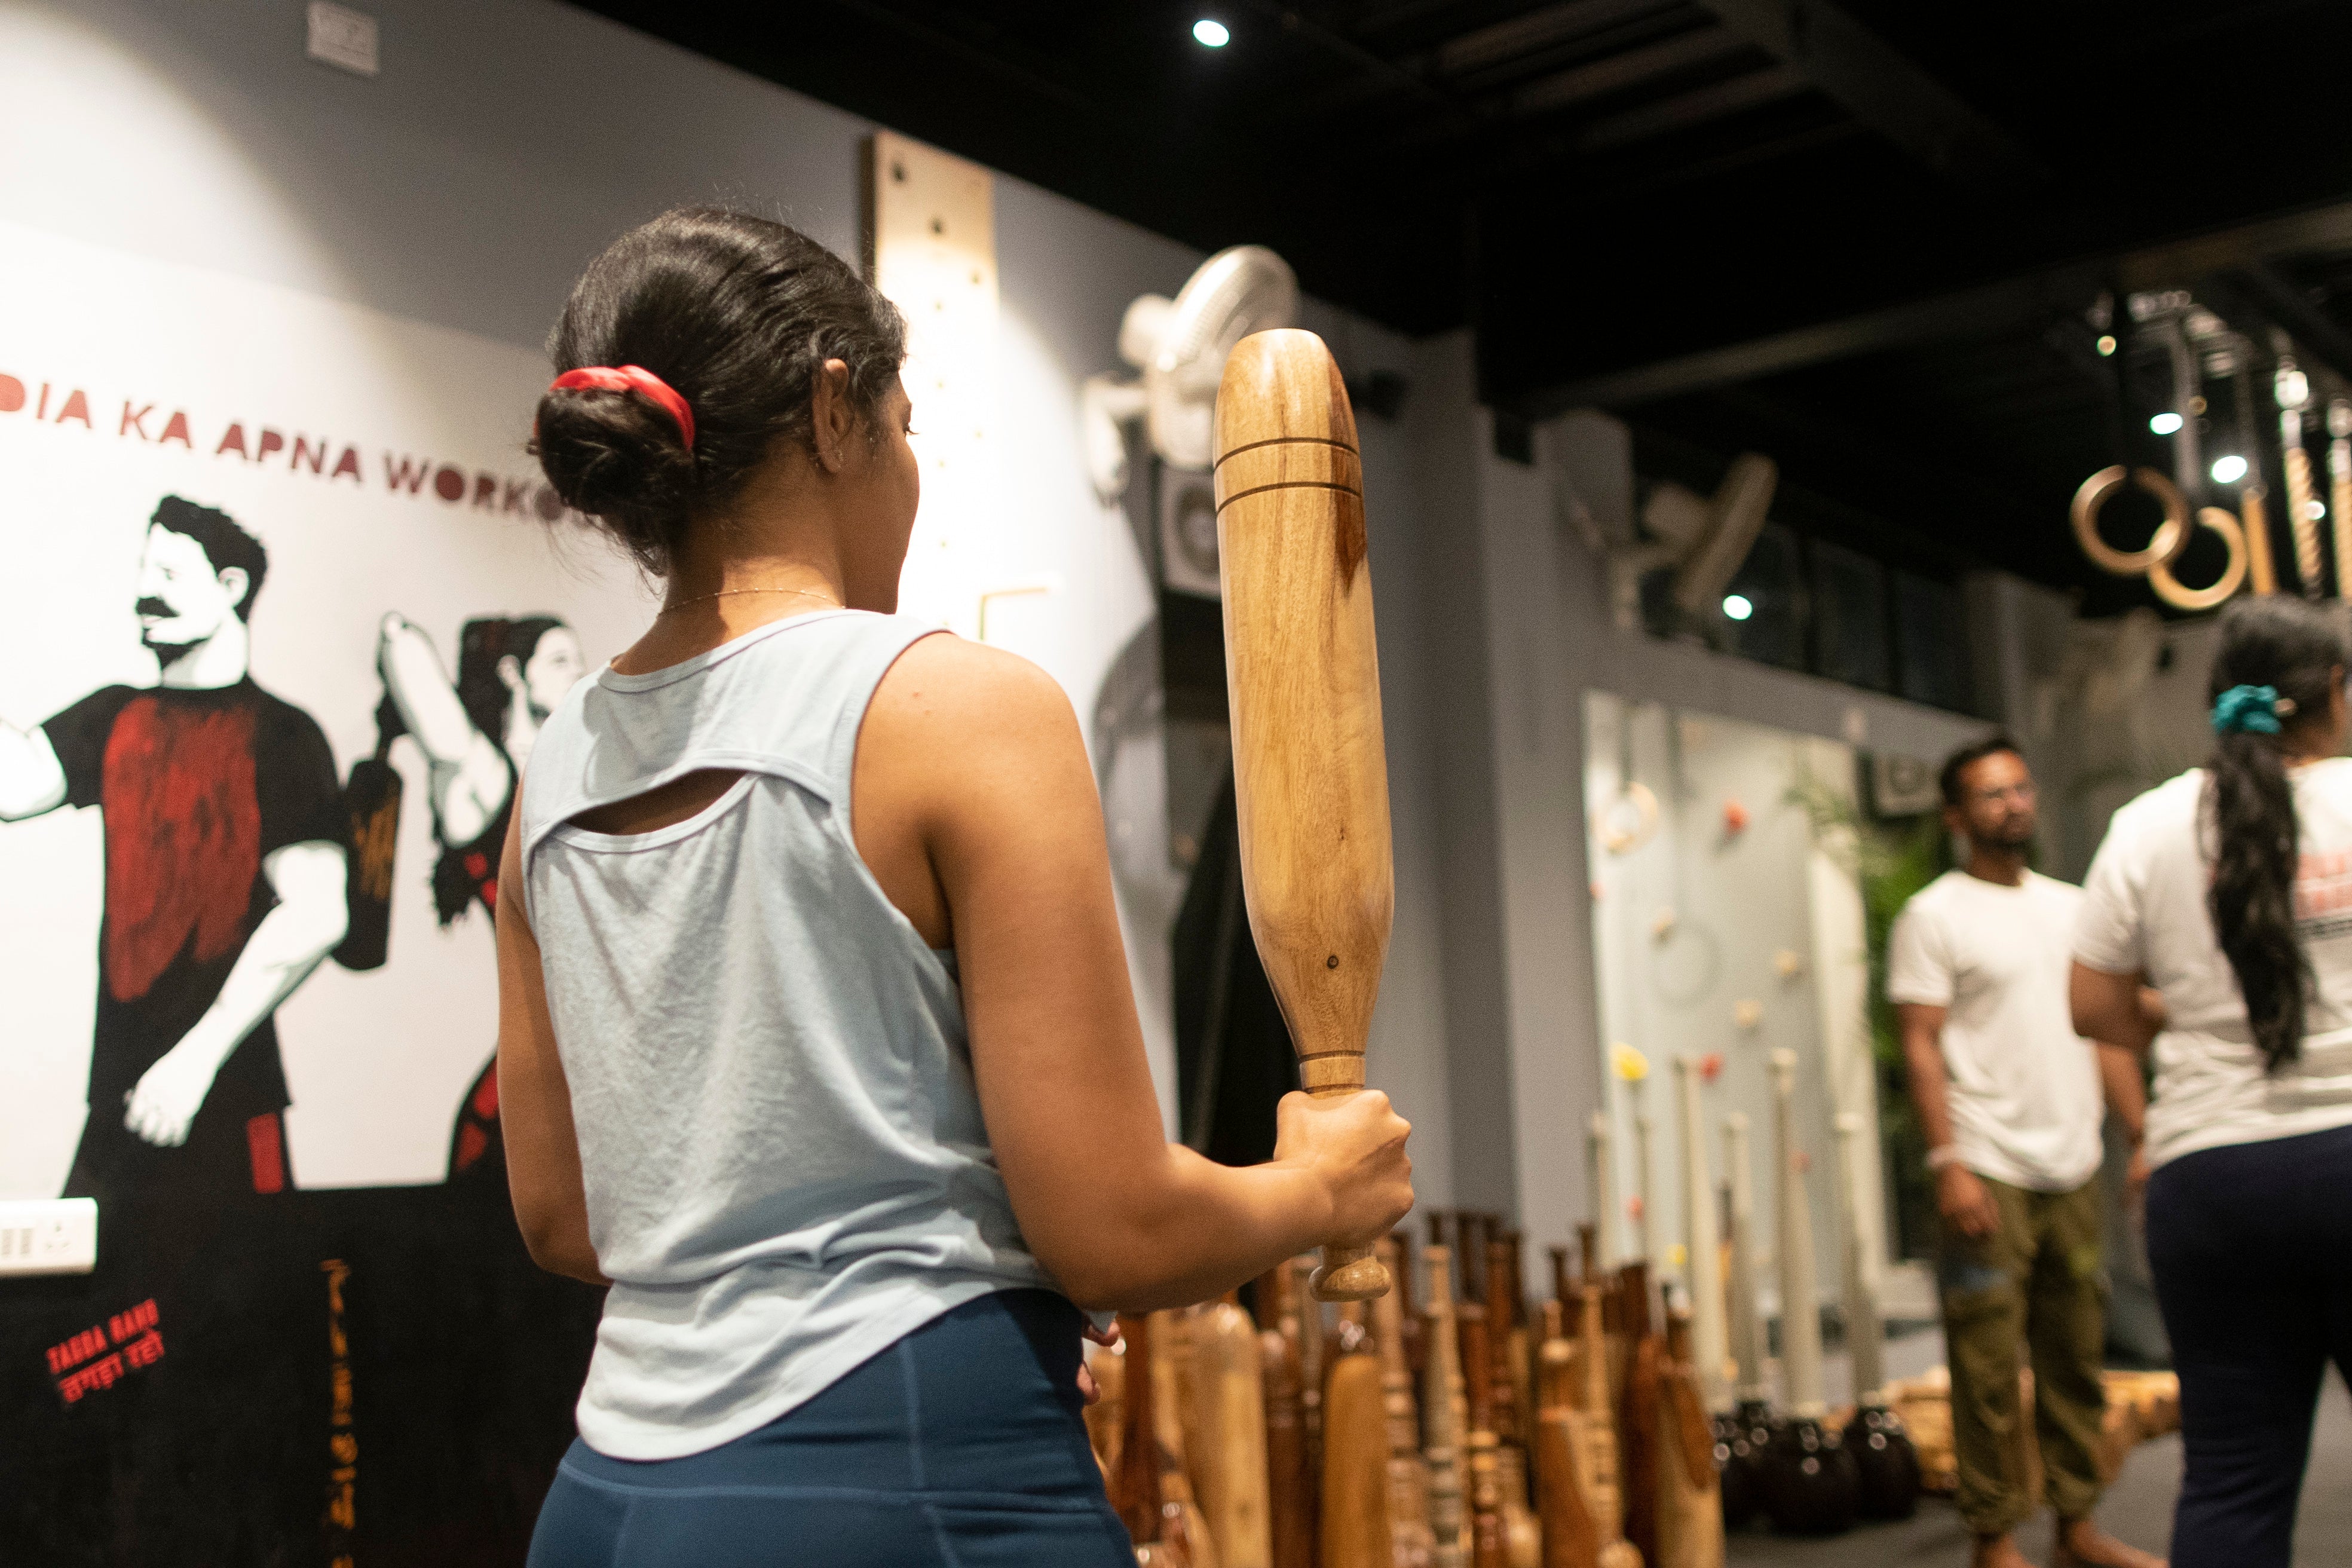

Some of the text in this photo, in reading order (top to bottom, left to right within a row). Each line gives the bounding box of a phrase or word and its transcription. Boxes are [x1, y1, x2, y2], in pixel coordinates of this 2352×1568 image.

[119, 400, 192, 449] KA
[215, 421, 363, 483] APNA
[384, 452, 592, 531] WORKO
